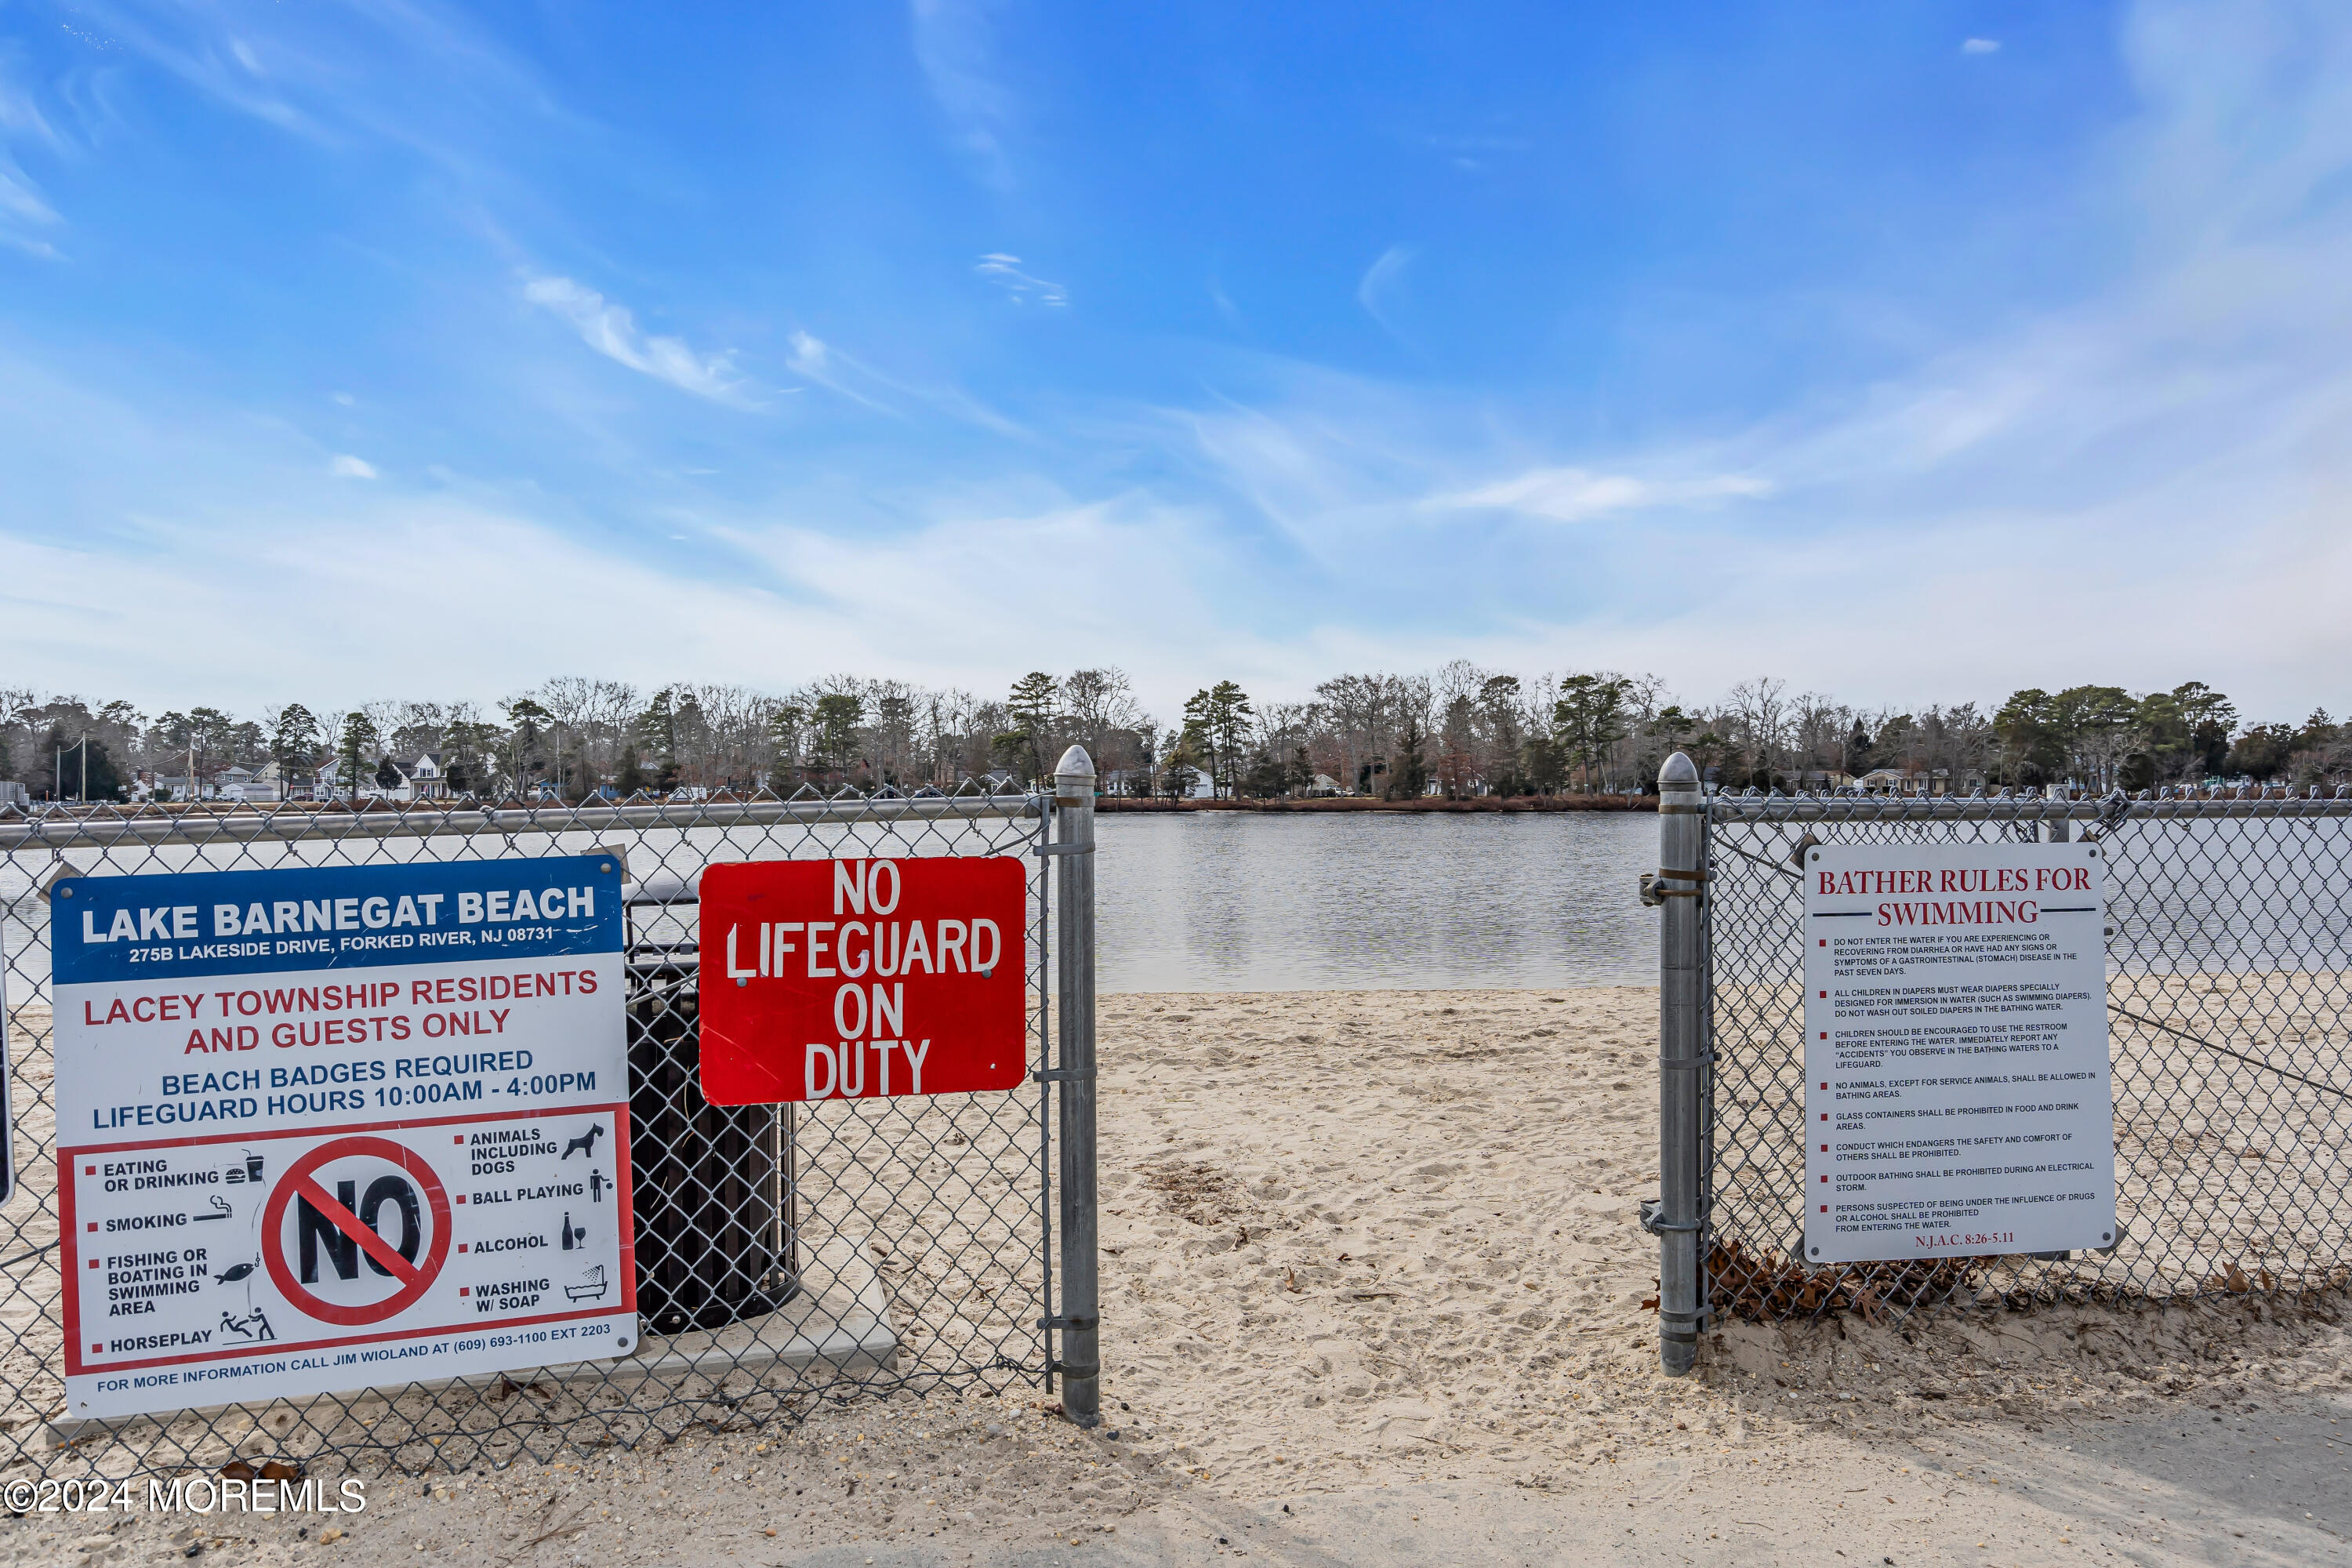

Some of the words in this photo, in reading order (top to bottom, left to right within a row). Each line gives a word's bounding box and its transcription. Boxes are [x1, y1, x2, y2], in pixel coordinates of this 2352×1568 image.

[834, 859, 901, 915] NO
[1818, 870, 1934, 894] BATHER
[1940, 869, 2028, 892] RULES
[2035, 868, 2092, 891] FOR
[83, 906, 198, 943] LAKE
[214, 894, 444, 936] BARNEGAT
[459, 887, 593, 924] BEACH
[1878, 901, 2038, 926] SWIMMING
[129, 947, 173, 962] 275B
[180, 942, 270, 960] LAKESIDE
[276, 938, 336, 956] DRIVE,
[340, 934, 414, 951] FORKED
[419, 931, 476, 946] RIVER,
[481, 930, 504, 943] NJ
[507, 926, 554, 942] 08731
[727, 918, 1001, 978] LIFEGUARD
[1899, 956, 1974, 964] GASTROINTESTINAL
[1976, 955, 2017, 964] (STOMACH)
[85, 994, 205, 1025] LACEY
[215, 982, 399, 1017] TOWNSHIP
[412, 970, 597, 1004] RESIDENTS
[834, 983, 903, 1040] ON
[184, 1026, 259, 1054] AND
[272, 1015, 411, 1048] GUESTS
[423, 1009, 510, 1037] ONLY
[1924, 1026, 1977, 1035] ENCOURAGED
[162, 1069, 260, 1095] BEACH
[271, 1061, 386, 1087] BADGES
[396, 1051, 532, 1078] REQUIRED
[805, 1039, 931, 1100] DUTY
[94, 1098, 257, 1129] LIFEGUARD
[268, 1090, 365, 1116] HOURS
[376, 1080, 481, 1106] 10:00AM
[507, 1072, 595, 1096] 4:00PM
[470, 1128, 540, 1145] ANIMALS
[472, 1142, 557, 1160] INCLUDING
[104, 1160, 167, 1176] EATING
[472, 1160, 514, 1175] DOGS
[1956, 1167, 2002, 1176] PROHIBITED
[2048, 1163, 2094, 1171] ELECTRICAL
[105, 1179, 129, 1192] OR
[135, 1171, 219, 1189] DRINKING
[473, 1190, 512, 1204] BALL
[517, 1183, 583, 1200] PLAYING
[1877, 1202, 1924, 1210] SUSPECTED
[2012, 1195, 2054, 1203] INFLUENCE
[107, 1214, 187, 1232] SMOKING
[1932, 1209, 1979, 1218] PROHIBITED
[297, 1174, 422, 1284] NO
[474, 1236, 548, 1254] ALCOHOL
[1915, 1235, 1962, 1249] N.J.A.C.
[1965, 1232, 2013, 1244] 8:26-5.11
[107, 1251, 177, 1269] FISHING
[183, 1248, 207, 1261] OR
[108, 1266, 183, 1285] BOATING
[191, 1264, 207, 1276] IN
[109, 1280, 199, 1301] SWIMMING
[476, 1279, 550, 1298] WASHING
[109, 1301, 155, 1316] AREA
[477, 1299, 494, 1312] W/
[499, 1294, 539, 1309] SOAP
[111, 1330, 212, 1352] HORSEPLAY
[98, 1379, 129, 1392] FOR
[134, 1374, 178, 1388] MORE
[183, 1362, 285, 1382] INFORMATION
[291, 1357, 329, 1370] CALL
[333, 1353, 356, 1365] JIM
[361, 1345, 428, 1362] WIOLAND
[433, 1343, 449, 1354] AT
[454, 1338, 485, 1354] (609)
[490, 1332, 546, 1347] 693-1100
[551, 1328, 577, 1340] EXT
[581, 1324, 610, 1336] 2203
